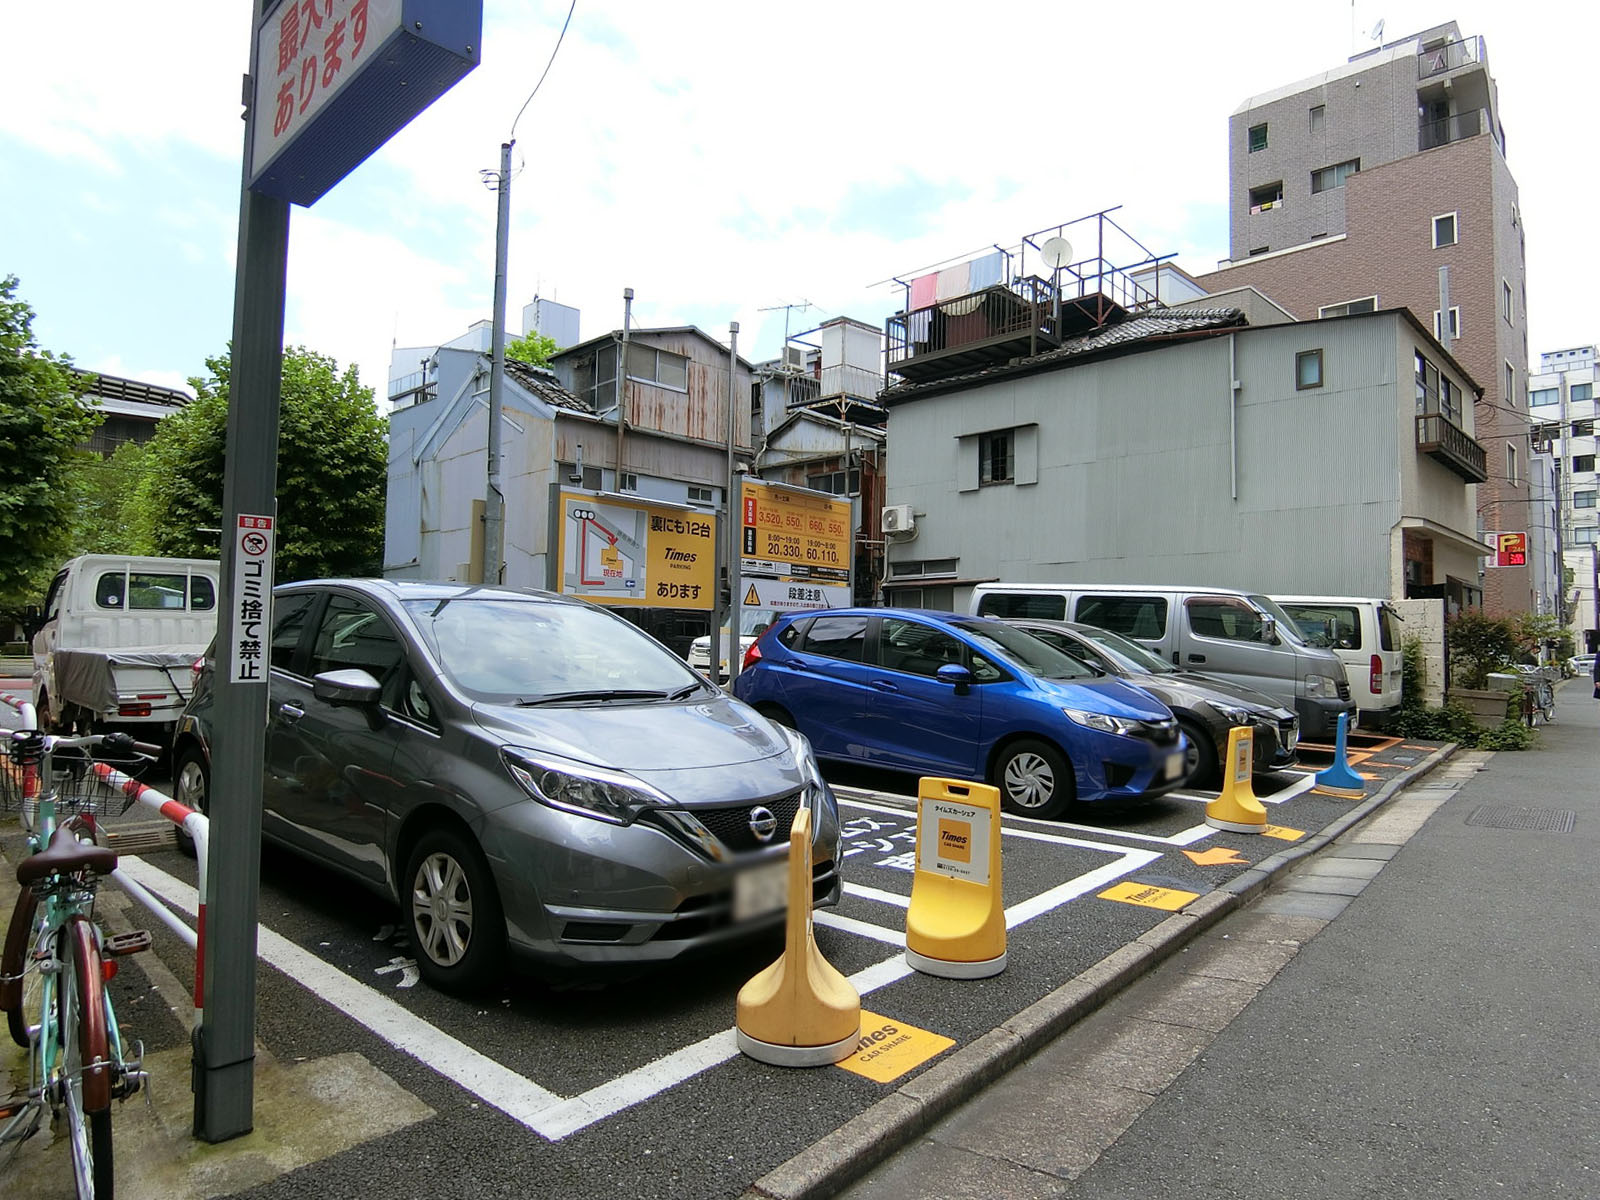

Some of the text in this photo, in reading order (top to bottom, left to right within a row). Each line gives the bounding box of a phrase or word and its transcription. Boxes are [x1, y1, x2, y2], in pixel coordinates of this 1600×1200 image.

[273, 0, 368, 137] あります
[651, 515, 711, 538] 裏にも12台
[758, 511, 783, 526] 3,520
[785, 516, 802, 529] 550
[828, 523, 844, 535] 550
[664, 547, 697, 562] Times
[602, 568, 623, 578] 現在地
[657, 582, 701, 600] あります
[788, 587, 821, 601] 段差注意
[238, 560, 265, 680] ゴミ捨て禁止
[935, 805, 976, 818] タイムズカーシェア
[941, 830, 968, 844] Times
[856, 1024, 899, 1052] mes
